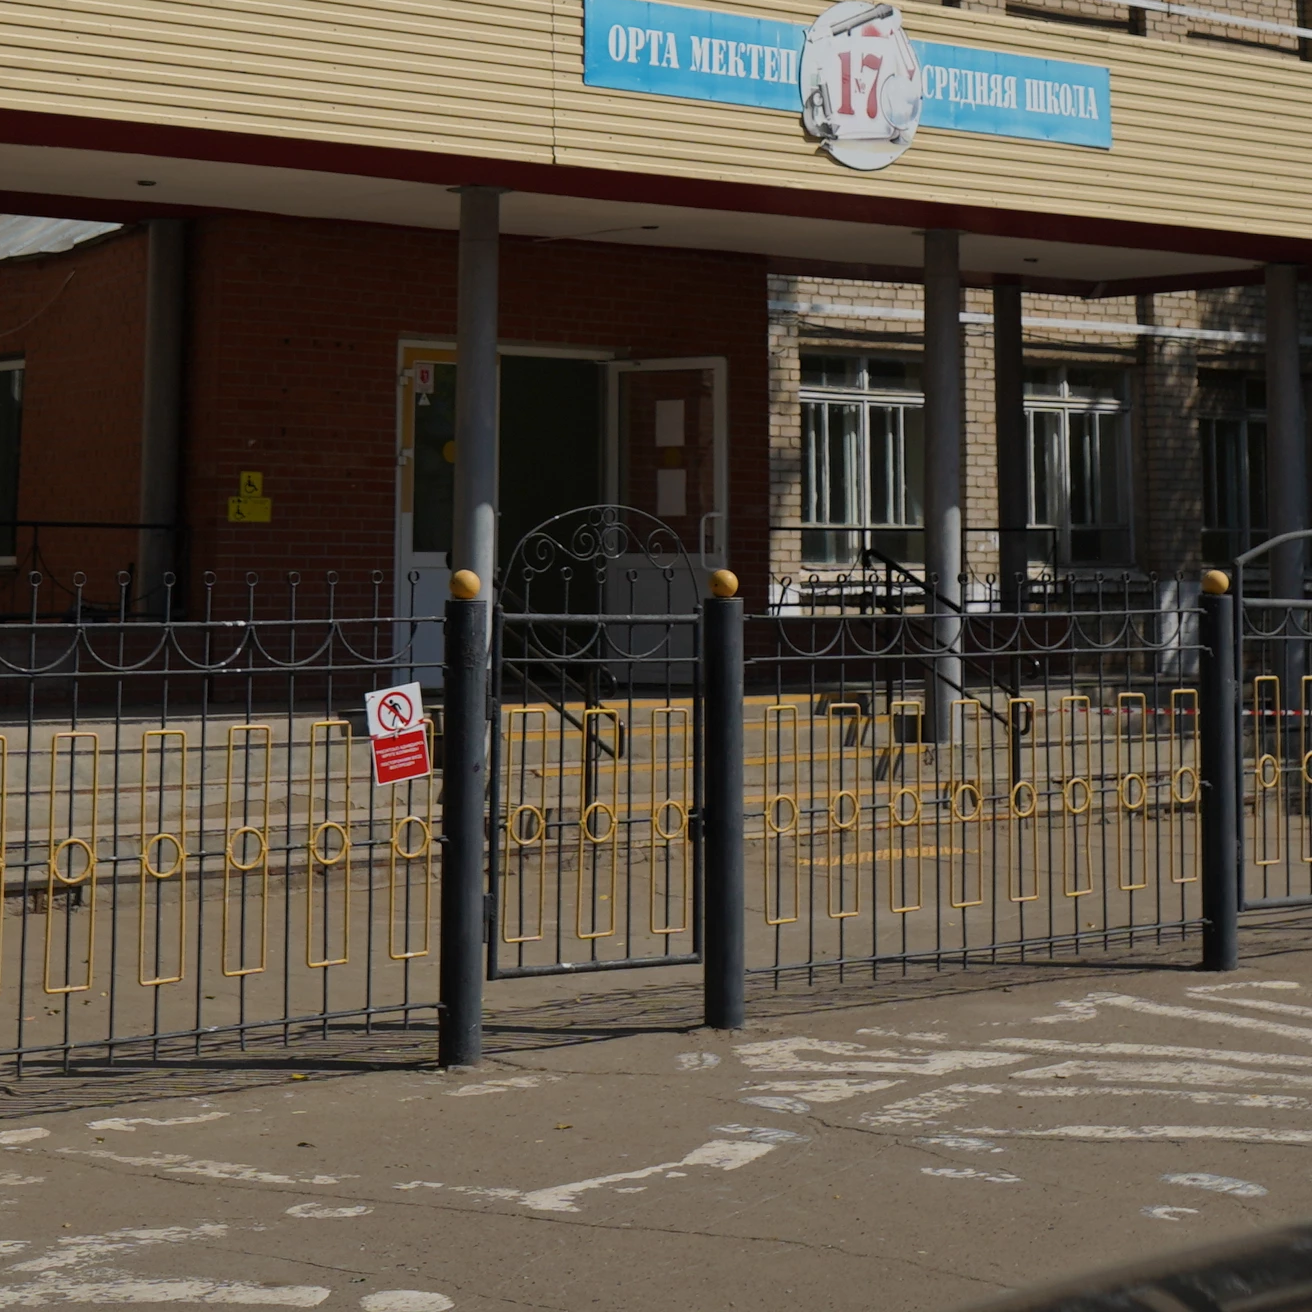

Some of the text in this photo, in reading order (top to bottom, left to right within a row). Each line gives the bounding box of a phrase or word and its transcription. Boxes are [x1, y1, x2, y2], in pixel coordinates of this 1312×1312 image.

[608, 24, 798, 85] ОРТА МЕКТЕП
[837, 50, 884, 119] 17
[922, 64, 1099, 120] СРЕДНЯЯ ШКОЛА
